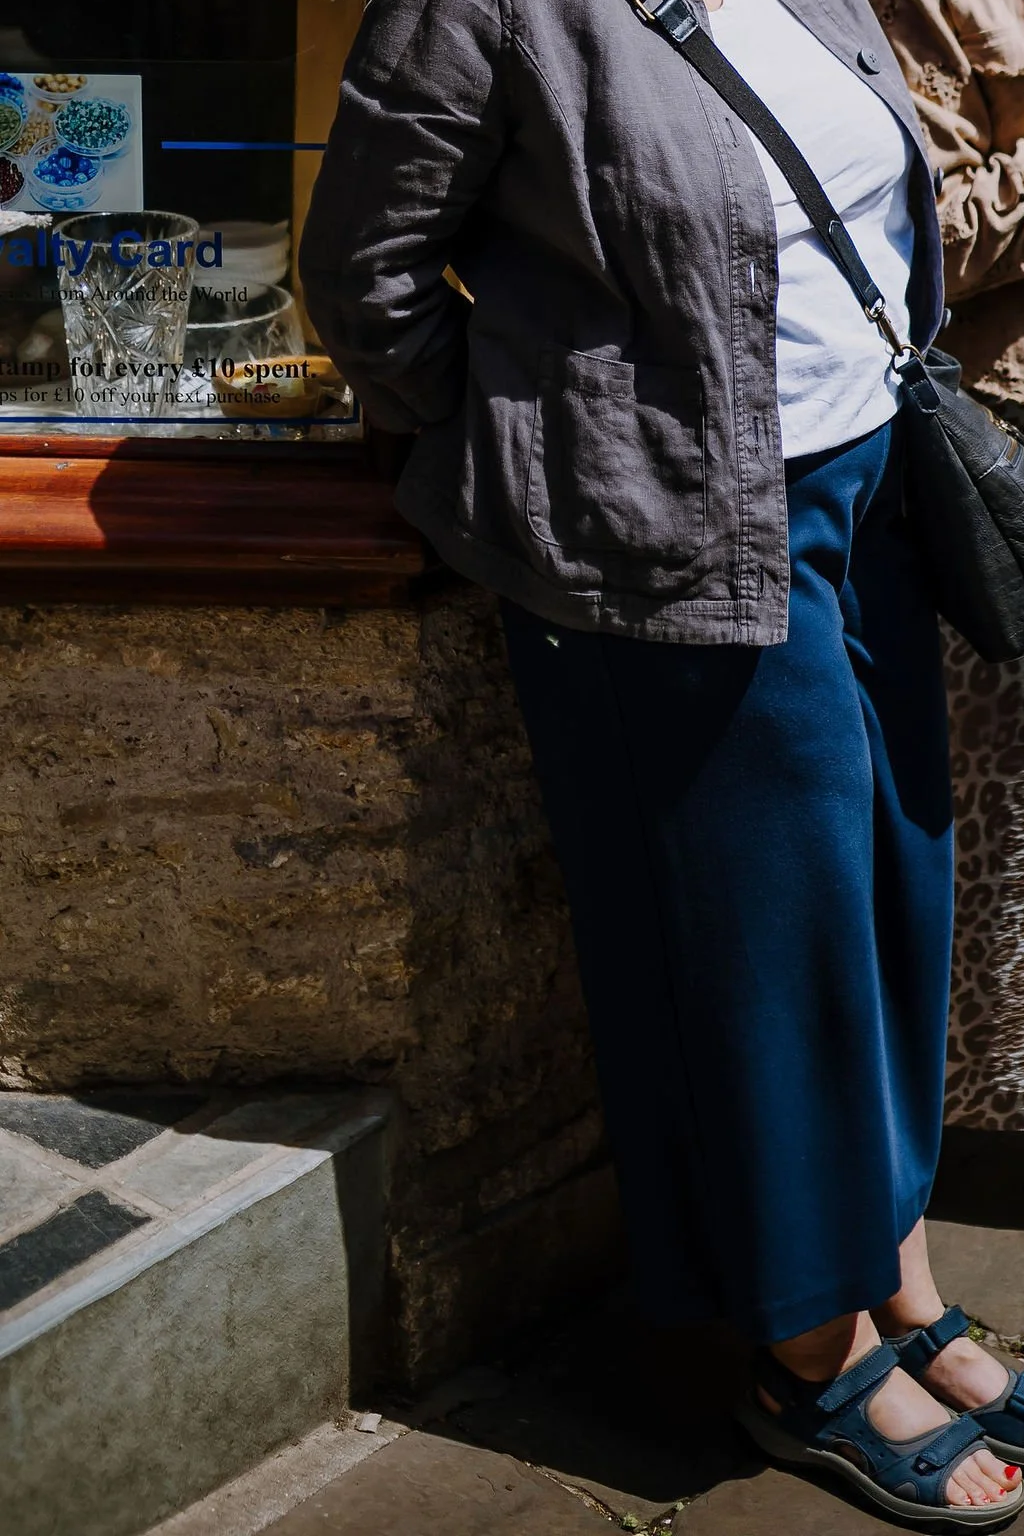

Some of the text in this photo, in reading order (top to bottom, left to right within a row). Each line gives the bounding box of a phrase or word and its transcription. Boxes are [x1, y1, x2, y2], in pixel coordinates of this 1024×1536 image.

[0, 227, 223, 276] alty Card
[40, 286, 84, 301] From
[91, 286, 156, 302] Around
[162, 287, 188, 302] the
[195, 287, 248, 302] World
[70, 357, 106, 377] for
[115, 360, 184, 383] every
[191, 357, 236, 379] £10
[243, 360, 317, 383] spent.
[24, 387, 48, 402] for
[53, 387, 85, 402] £10
[90, 387, 117, 403] off
[120, 390, 159, 407] your
[165, 390, 200, 403] next
[206, 389, 281, 407] purchase
